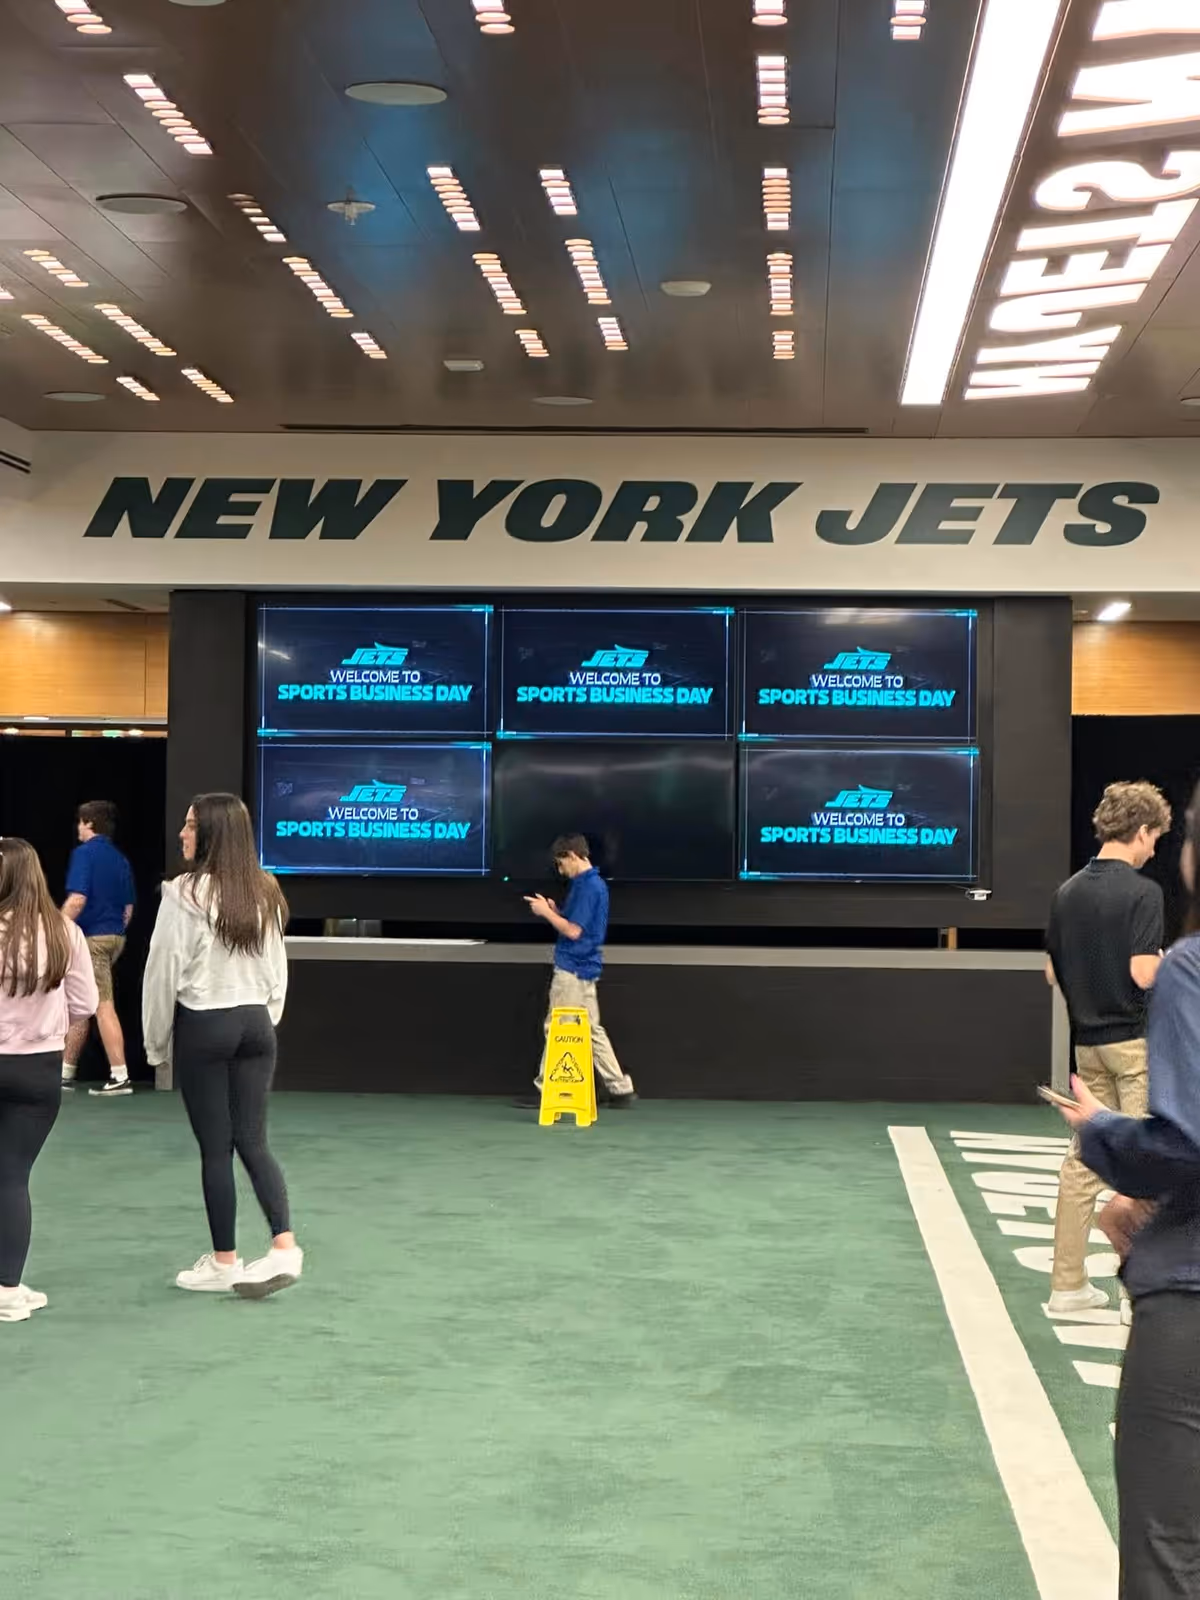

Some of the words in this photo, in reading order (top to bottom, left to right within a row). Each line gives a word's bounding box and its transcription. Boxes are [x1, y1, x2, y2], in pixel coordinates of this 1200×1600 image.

[83, 476, 409, 539] NEW
[429, 478, 804, 543] YORK
[815, 481, 1160, 547] JETS
[341, 642, 409, 665] JETS
[581, 644, 649, 667] JETS
[823, 646, 892, 670] JETS
[330, 670, 400, 683] WELCOME
[402, 670, 421, 683] TO
[569, 672, 640, 685] WELCOME
[643, 673, 661, 686] TO
[812, 674, 882, 688] WELCOME
[885, 675, 904, 688] TO
[278, 684, 348, 700] SPORTS
[350, 685, 434, 701] BUSINESS
[436, 685, 473, 702] DAY
[516, 686, 587, 703] SPORTS
[590, 687, 674, 704] BUSINESS
[677, 687, 713, 704] DAY
[758, 688, 829, 704] SPORTS
[832, 690, 916, 706] BUSINESS
[919, 690, 956, 707] DAY
[339, 779, 407, 802] JETS
[825, 784, 893, 808] JETS
[328, 807, 397, 820] WELCOME
[400, 808, 419, 821] TO
[813, 812, 884, 826] WELCOME
[887, 813, 906, 826] TO
[276, 821, 345, 837] SPORTS
[348, 822, 431, 839] BUSINESS
[434, 823, 471, 839] DAY
[760, 827, 831, 843] SPORTS
[834, 828, 917, 844] BUSINESS
[920, 828, 958, 845] DAY
[554, 1035, 584, 1043] CAUTION
